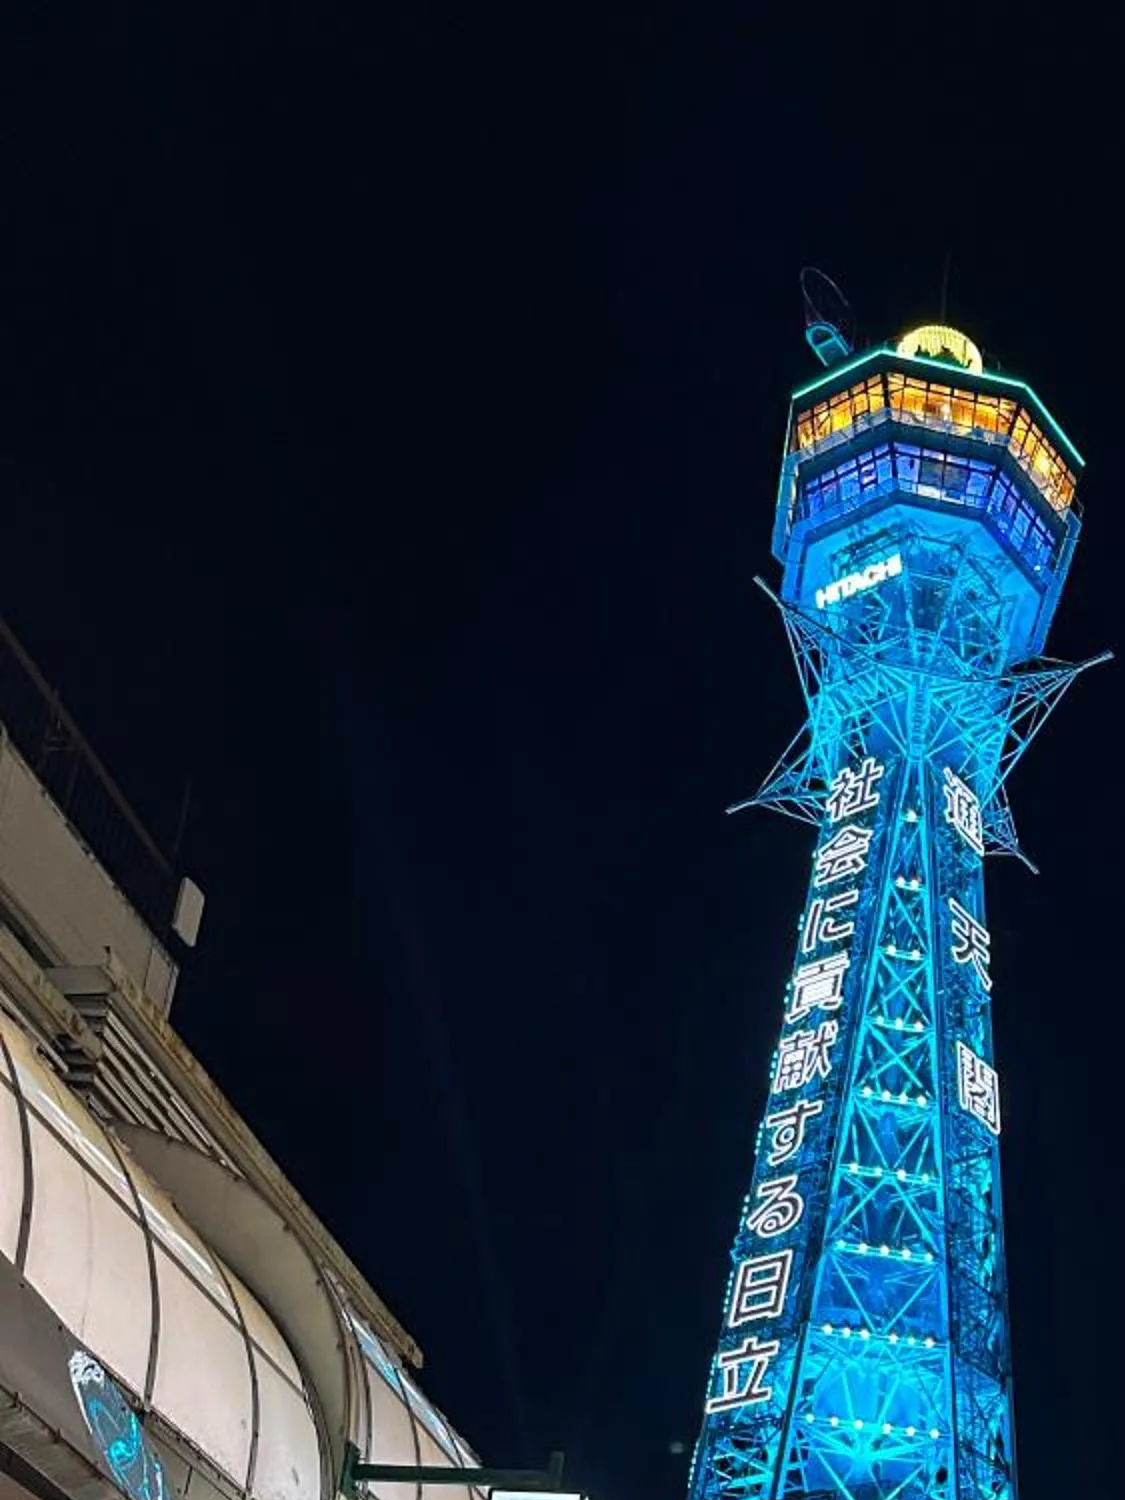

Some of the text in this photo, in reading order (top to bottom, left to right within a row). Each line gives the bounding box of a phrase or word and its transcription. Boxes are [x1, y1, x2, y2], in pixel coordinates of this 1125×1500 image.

[816, 552, 902, 608] HITACHI
[705, 757, 886, 1416] 社会に貢献する日立
[943, 767, 1001, 1136] 通天閣
